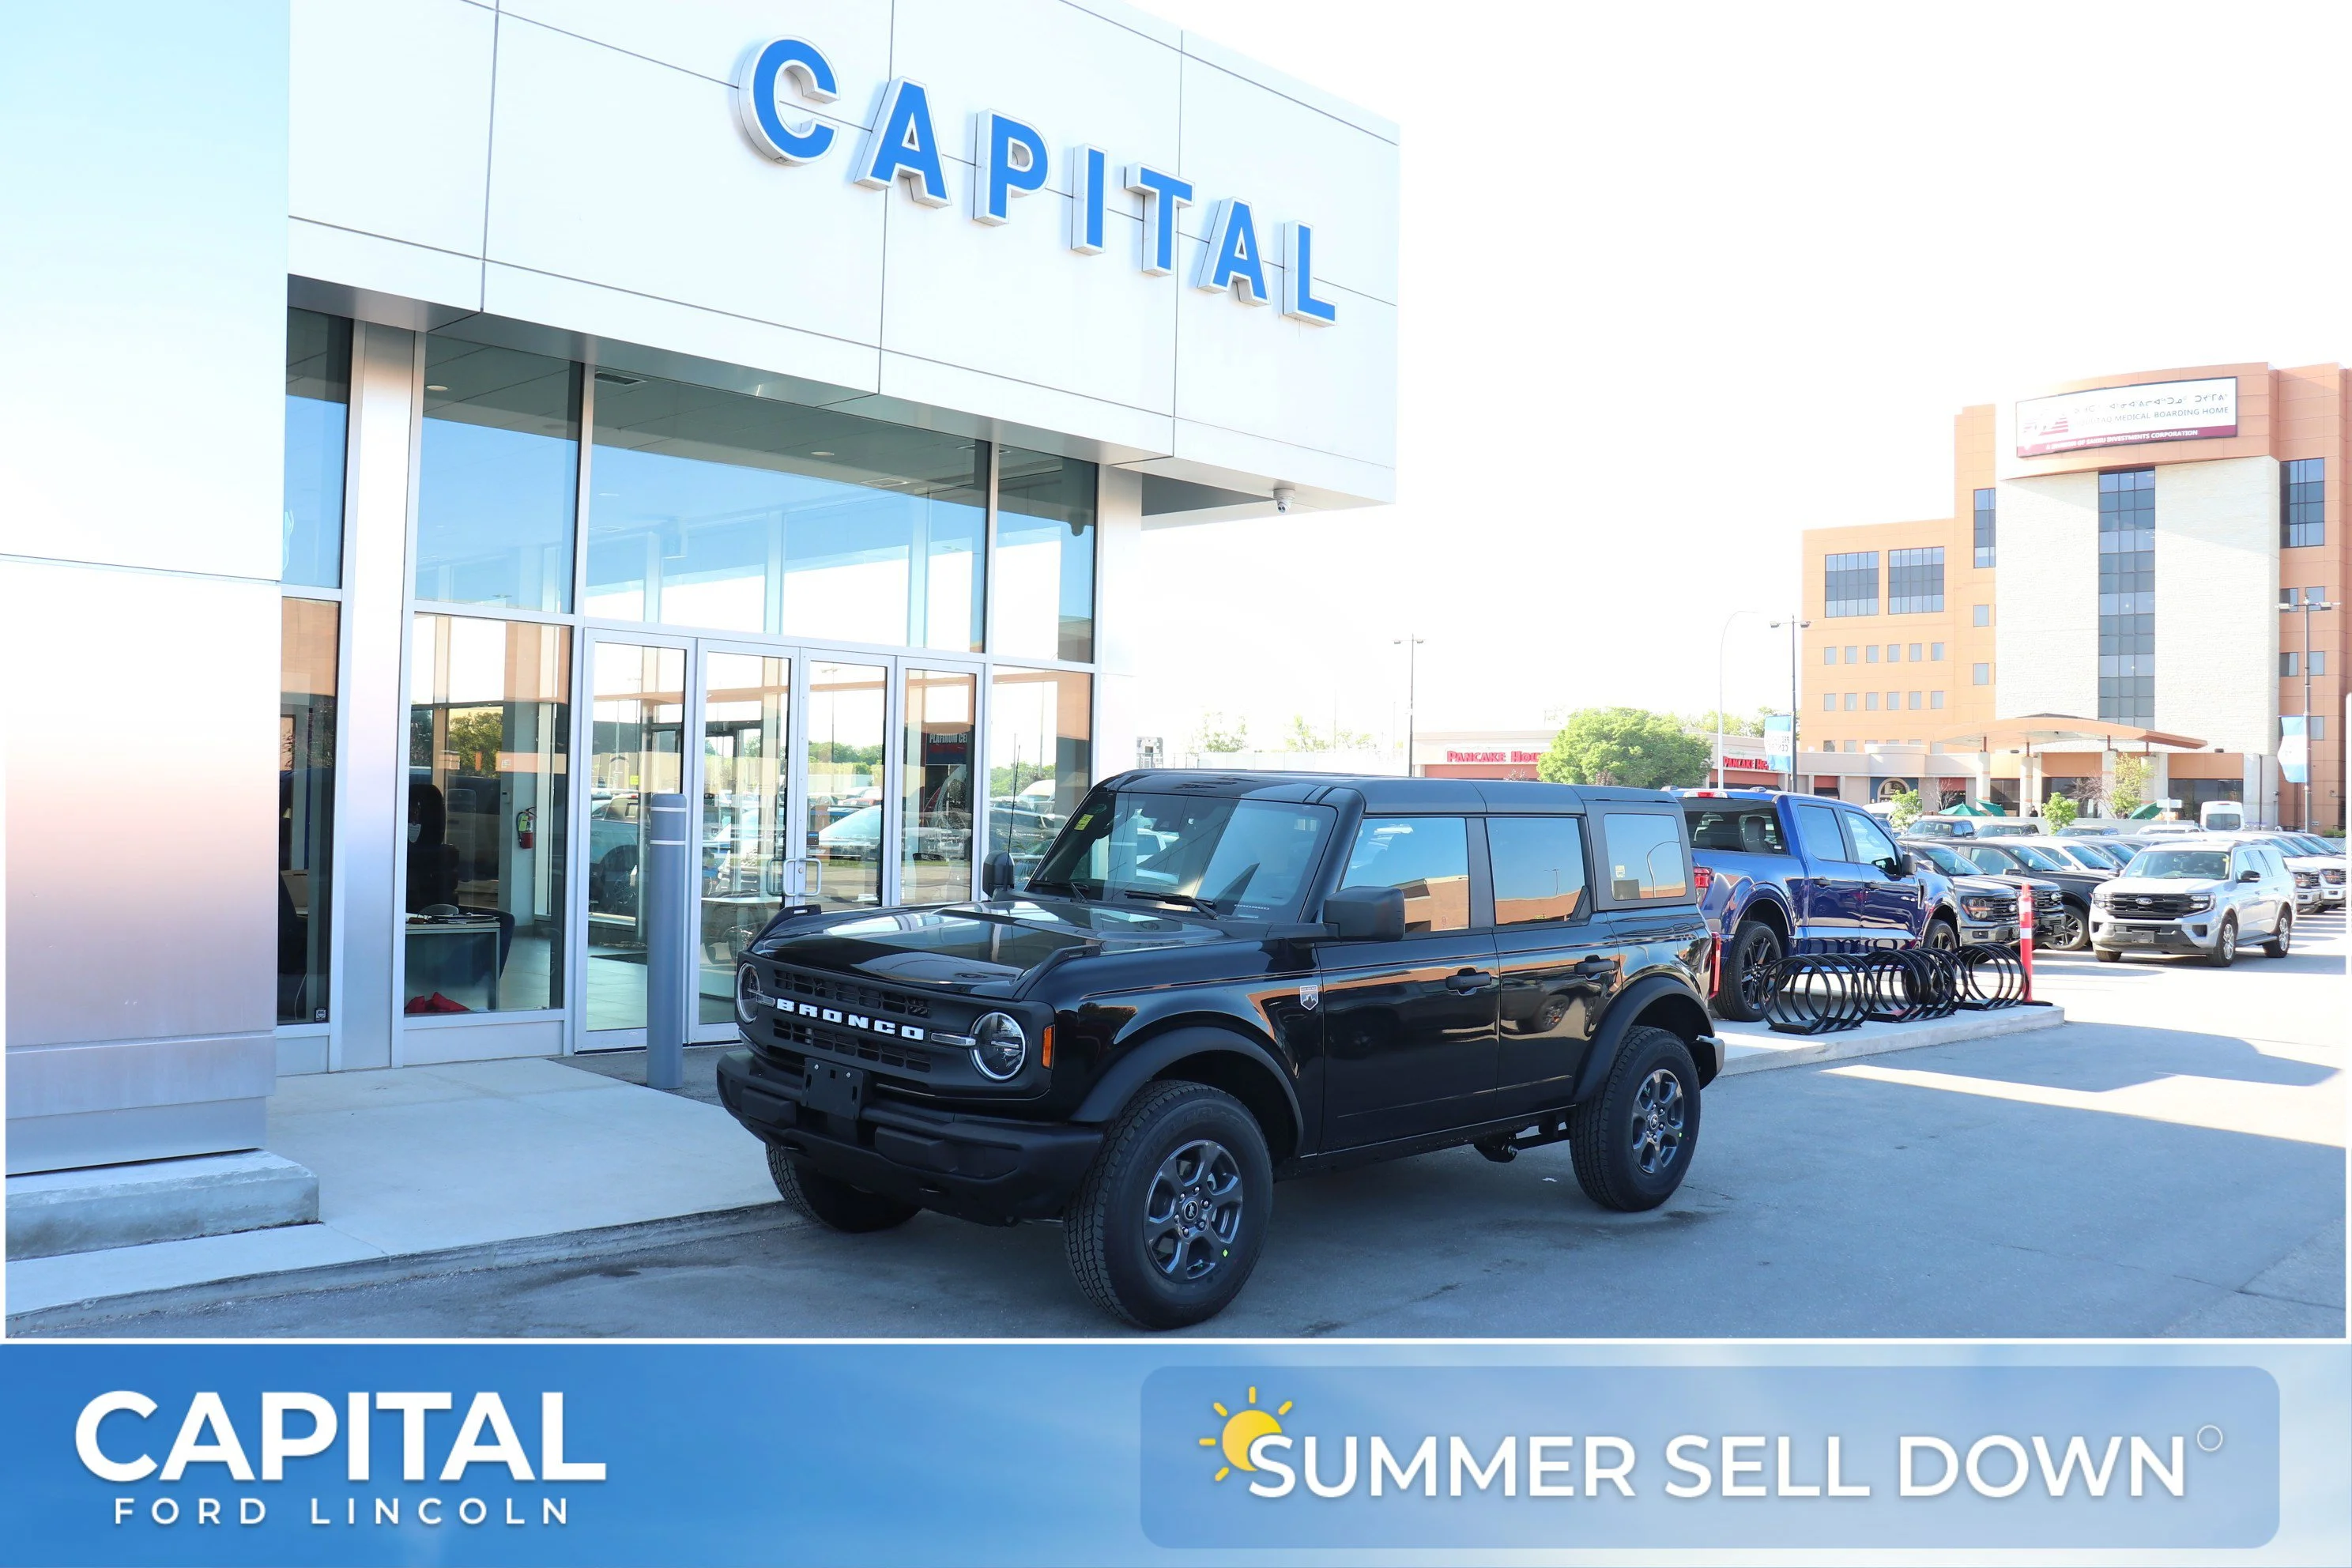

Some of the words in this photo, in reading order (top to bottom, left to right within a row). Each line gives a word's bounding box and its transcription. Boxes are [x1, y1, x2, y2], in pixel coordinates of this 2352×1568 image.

[739, 35, 1337, 326] CAPITAL
[2114, 413, 2150, 422] MEDICAL
[2154, 409, 2199, 418] BOARDING
[2202, 406, 2229, 415] HOME
[2106, 432, 2150, 443] INVESTMENTS
[2150, 429, 2199, 439] CORPORATION
[929, 733, 958, 743] PLATINUM
[1446, 750, 1506, 763] PANCAKE
[1723, 756, 1755, 769] PANCAKE
[776, 997, 924, 1041] BRONCO
